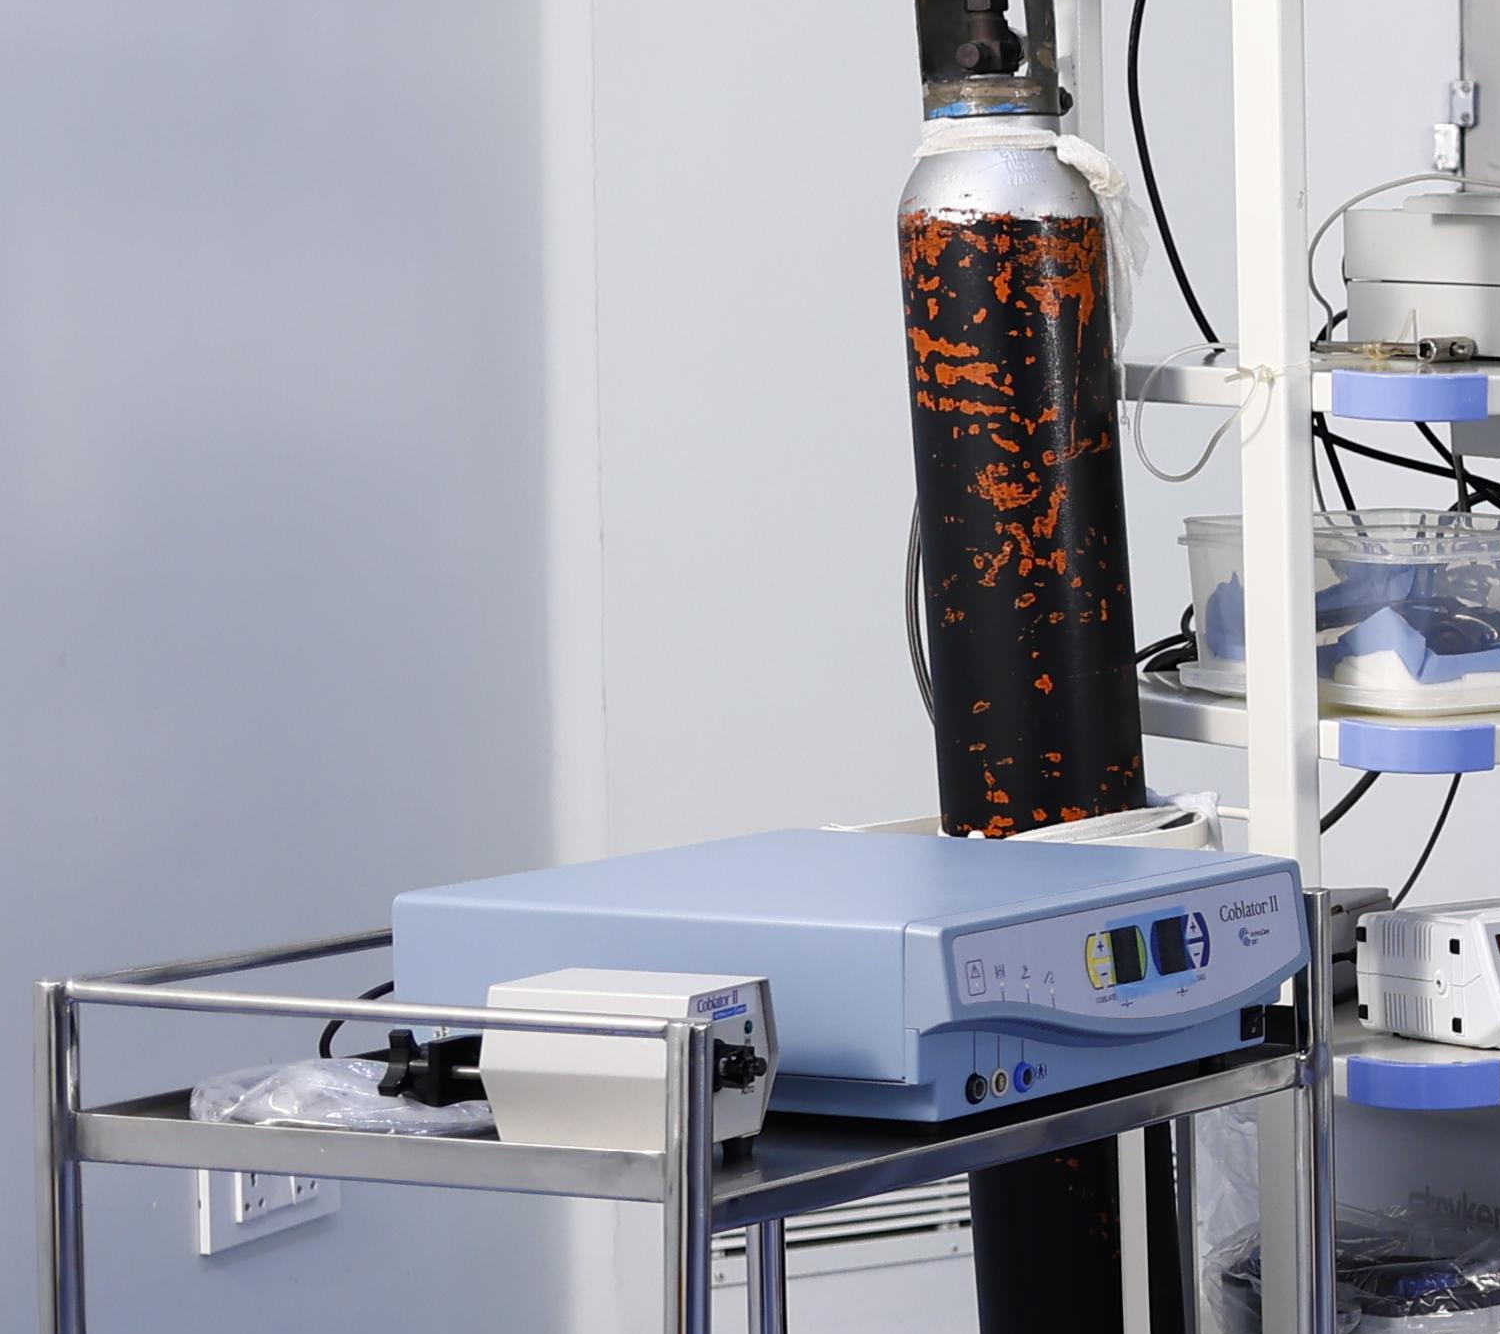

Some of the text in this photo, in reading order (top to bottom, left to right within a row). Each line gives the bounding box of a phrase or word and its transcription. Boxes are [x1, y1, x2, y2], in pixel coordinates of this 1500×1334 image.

[1220, 895, 1279, 922] Coblator II
[697, 994, 730, 1013] Coblator
[732, 989, 738, 1005] II
